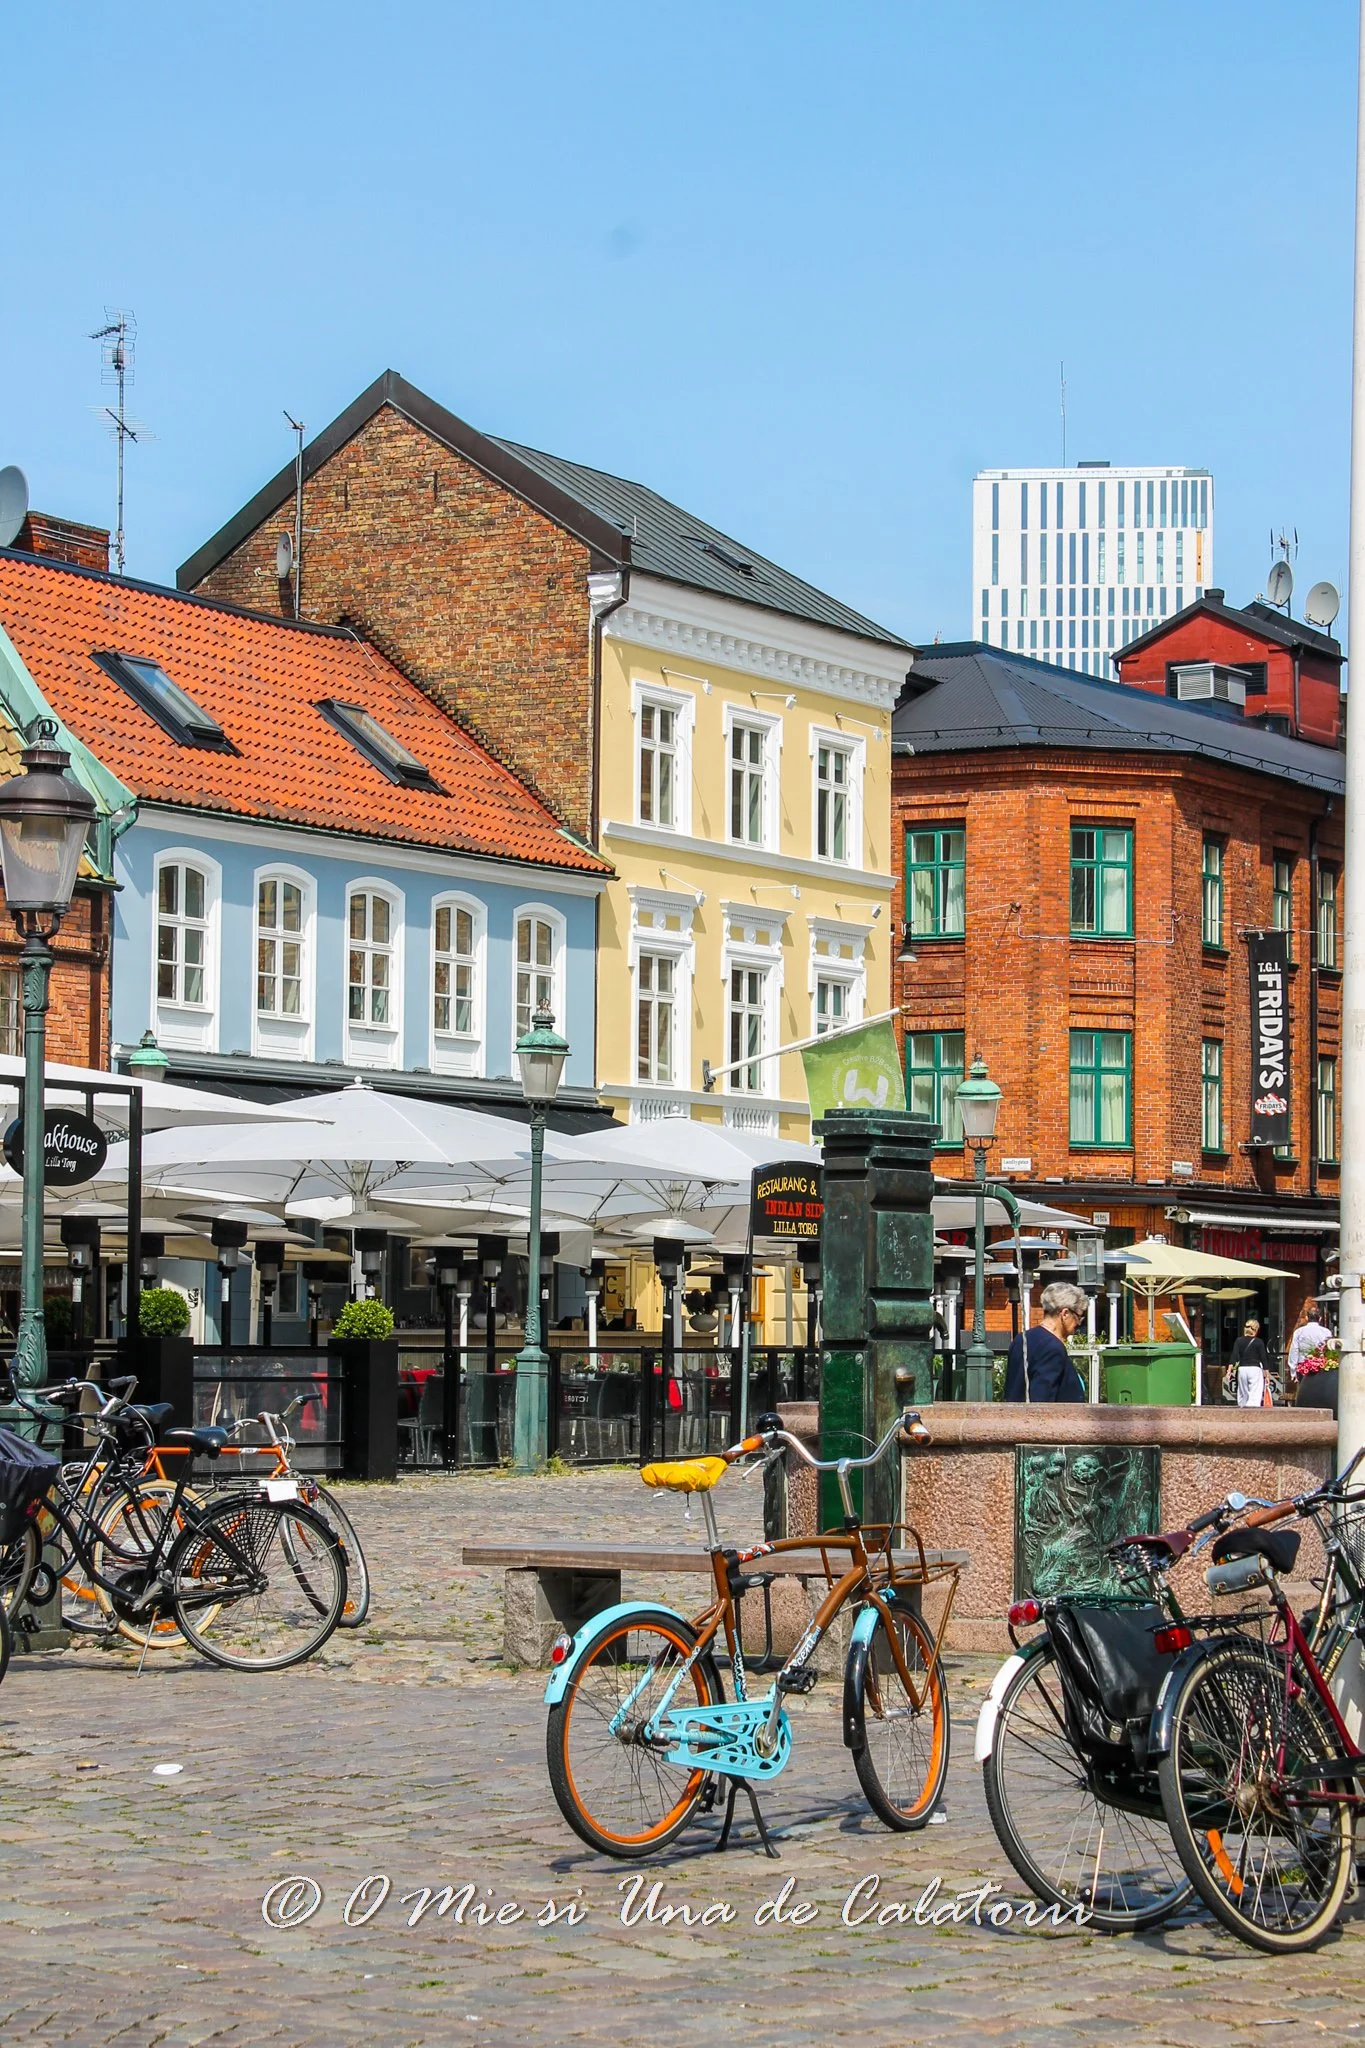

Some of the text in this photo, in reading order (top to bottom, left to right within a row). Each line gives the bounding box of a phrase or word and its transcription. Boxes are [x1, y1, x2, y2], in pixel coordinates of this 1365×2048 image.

[1257, 962, 1281, 973] T.G.I.
[61, 1157, 77, 1173] Torg
[757, 1177, 817, 1199] RESTAURANG &
[765, 1200, 803, 1217] INDIAN
[773, 1221, 818, 1235] LILLA TORG
